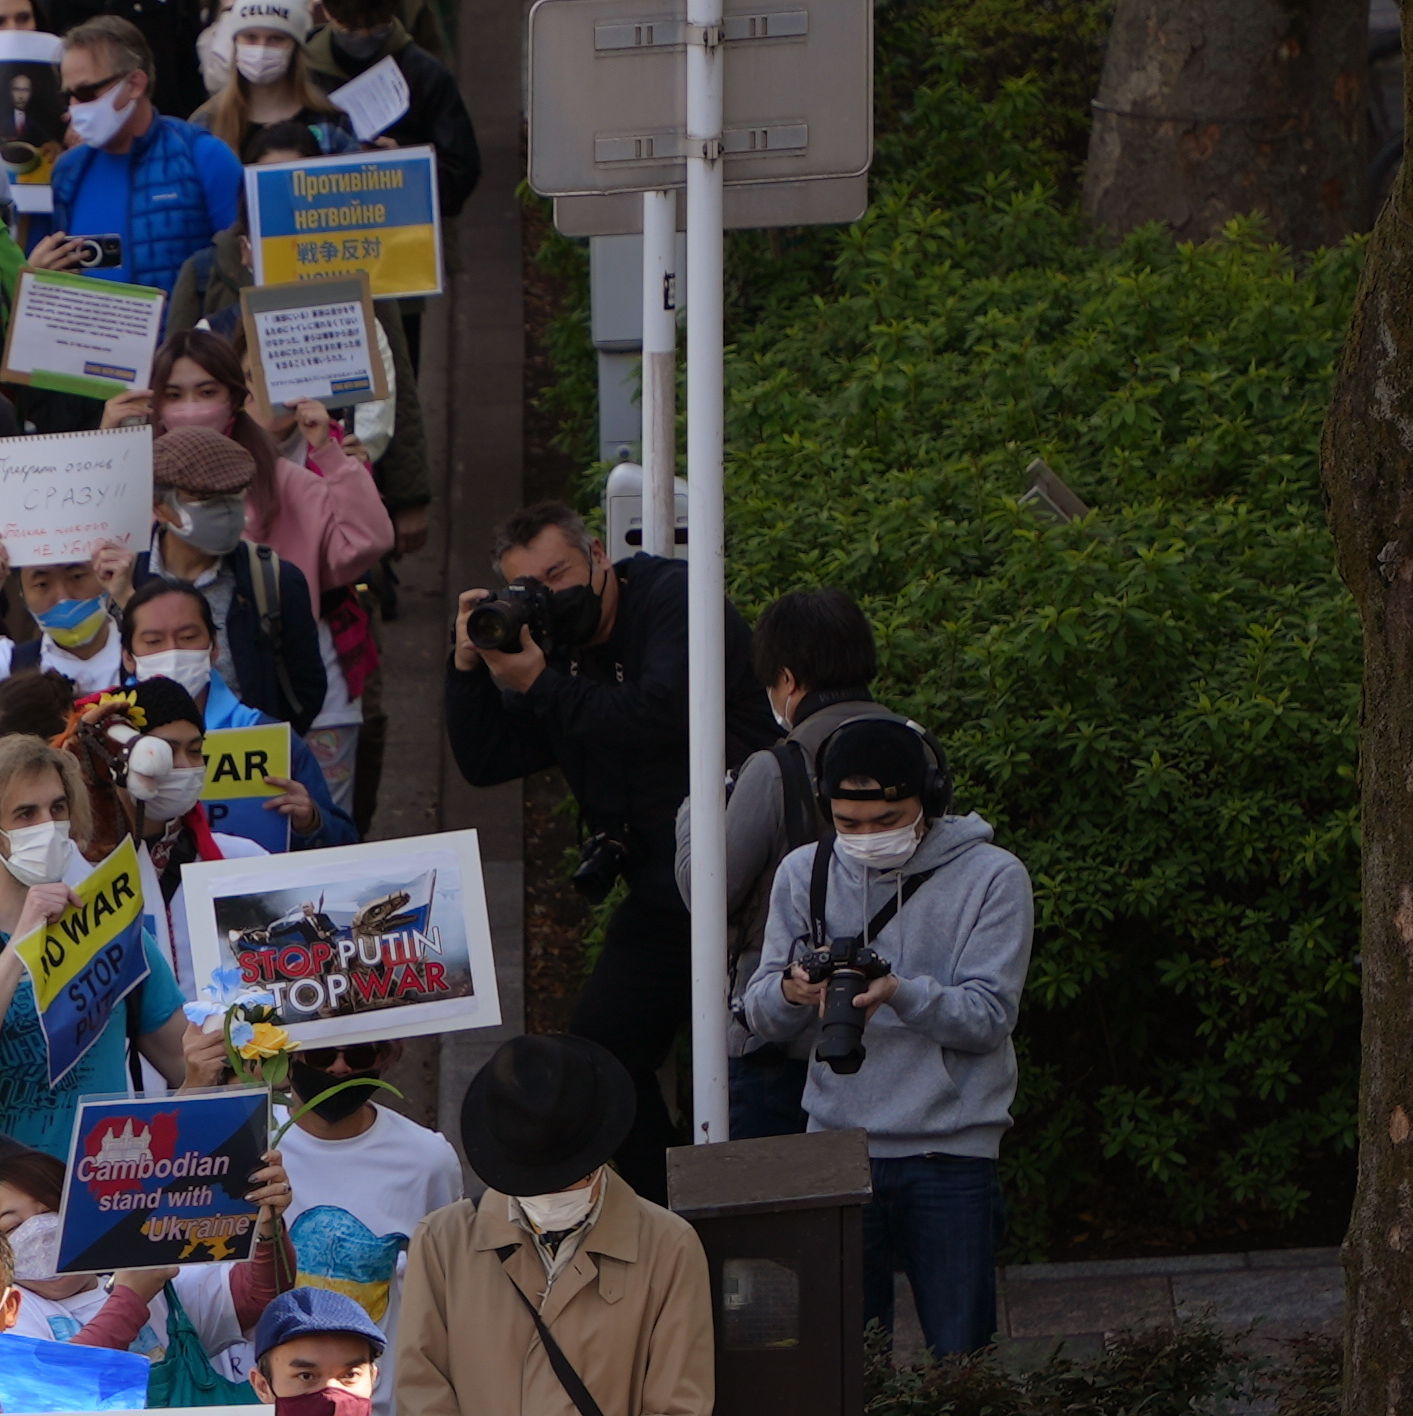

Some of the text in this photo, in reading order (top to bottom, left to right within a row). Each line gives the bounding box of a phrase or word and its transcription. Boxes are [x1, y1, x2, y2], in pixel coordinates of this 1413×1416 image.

[240, 4, 290, 20] CELINE
[296, 236, 382, 265] 戦争反対
[203, 749, 270, 783] AR
[60, 871, 137, 946] WAR
[239, 925, 444, 984] STOP PUTIN
[68, 942, 124, 1013] STOP
[247, 961, 451, 1018] TOP WAR
[76, 1151, 231, 1183] Cambodian
[98, 1184, 214, 1212] stand with
[147, 1212, 251, 1243] Ukraine
